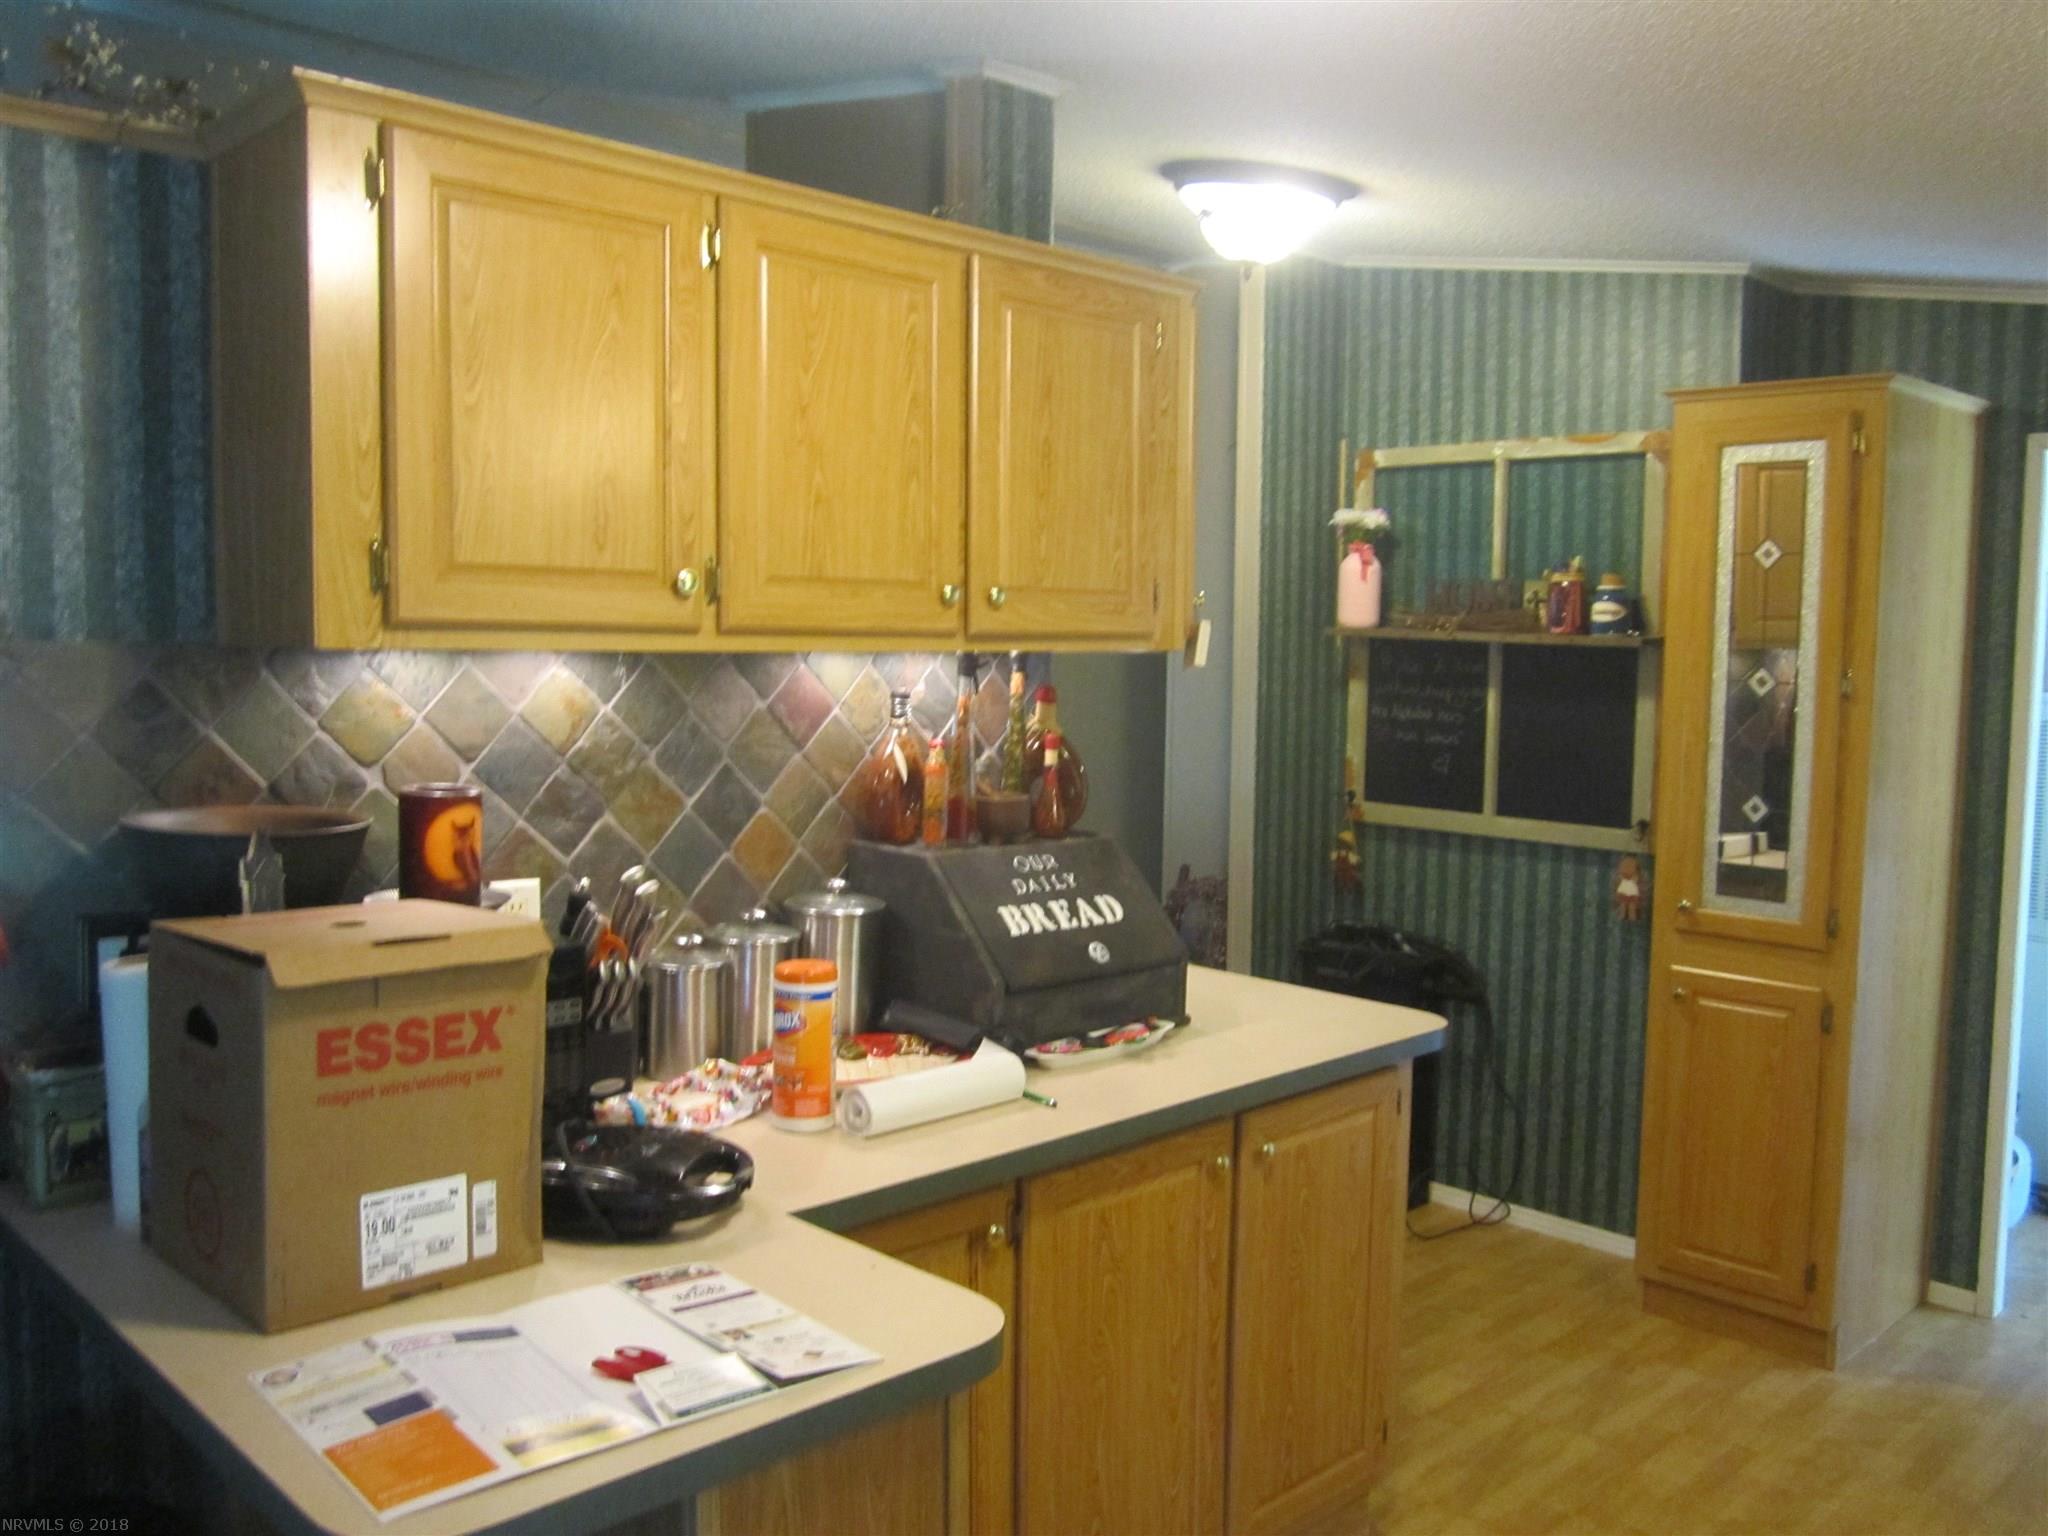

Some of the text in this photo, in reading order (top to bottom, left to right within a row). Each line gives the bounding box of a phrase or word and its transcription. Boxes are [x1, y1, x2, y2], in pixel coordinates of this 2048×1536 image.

[1013, 853, 1058, 873] OUR
[1011, 872, 1077, 896] DAILY
[997, 894, 1124, 938] BREAD
[315, 1006, 503, 1078] ESSEX
